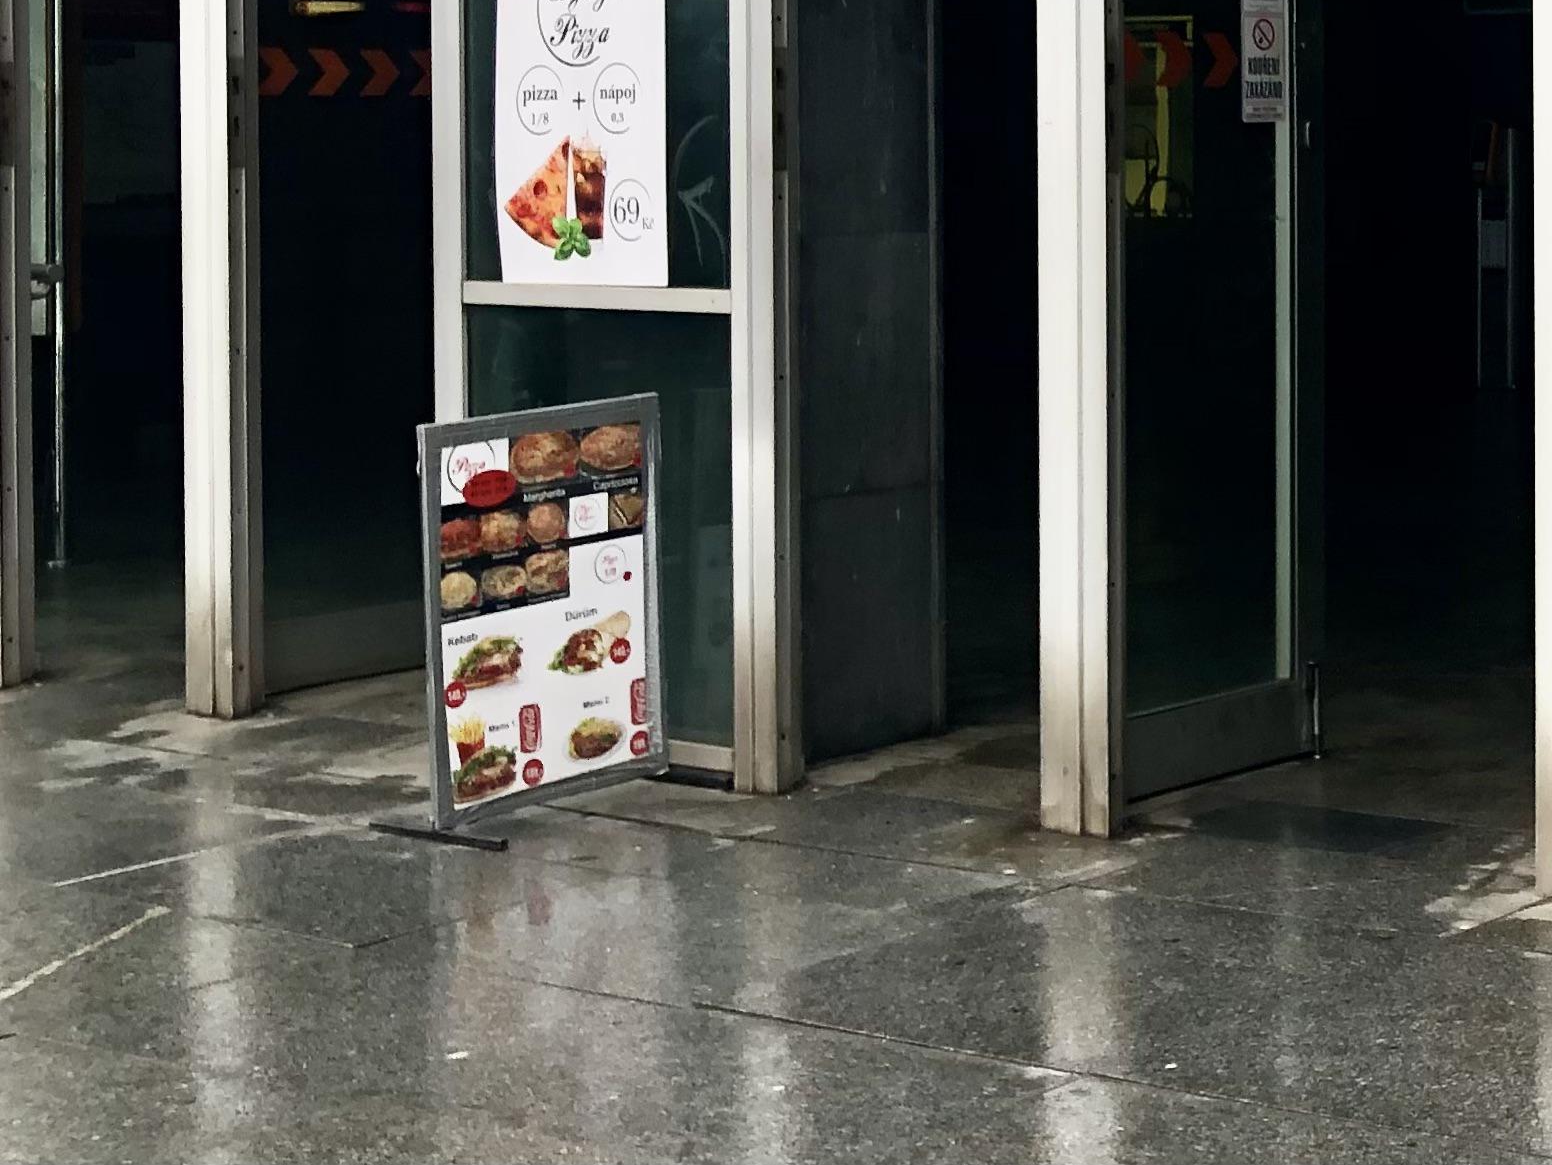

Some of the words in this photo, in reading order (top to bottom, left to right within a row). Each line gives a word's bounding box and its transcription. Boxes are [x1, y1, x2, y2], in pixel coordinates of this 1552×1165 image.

[550, 13, 610, 60] Pizza
[523, 84, 558, 107] pizza
[599, 83, 636, 105] nápoj
[531, 112, 549, 126] 1/8
[613, 196, 640, 224] 69
